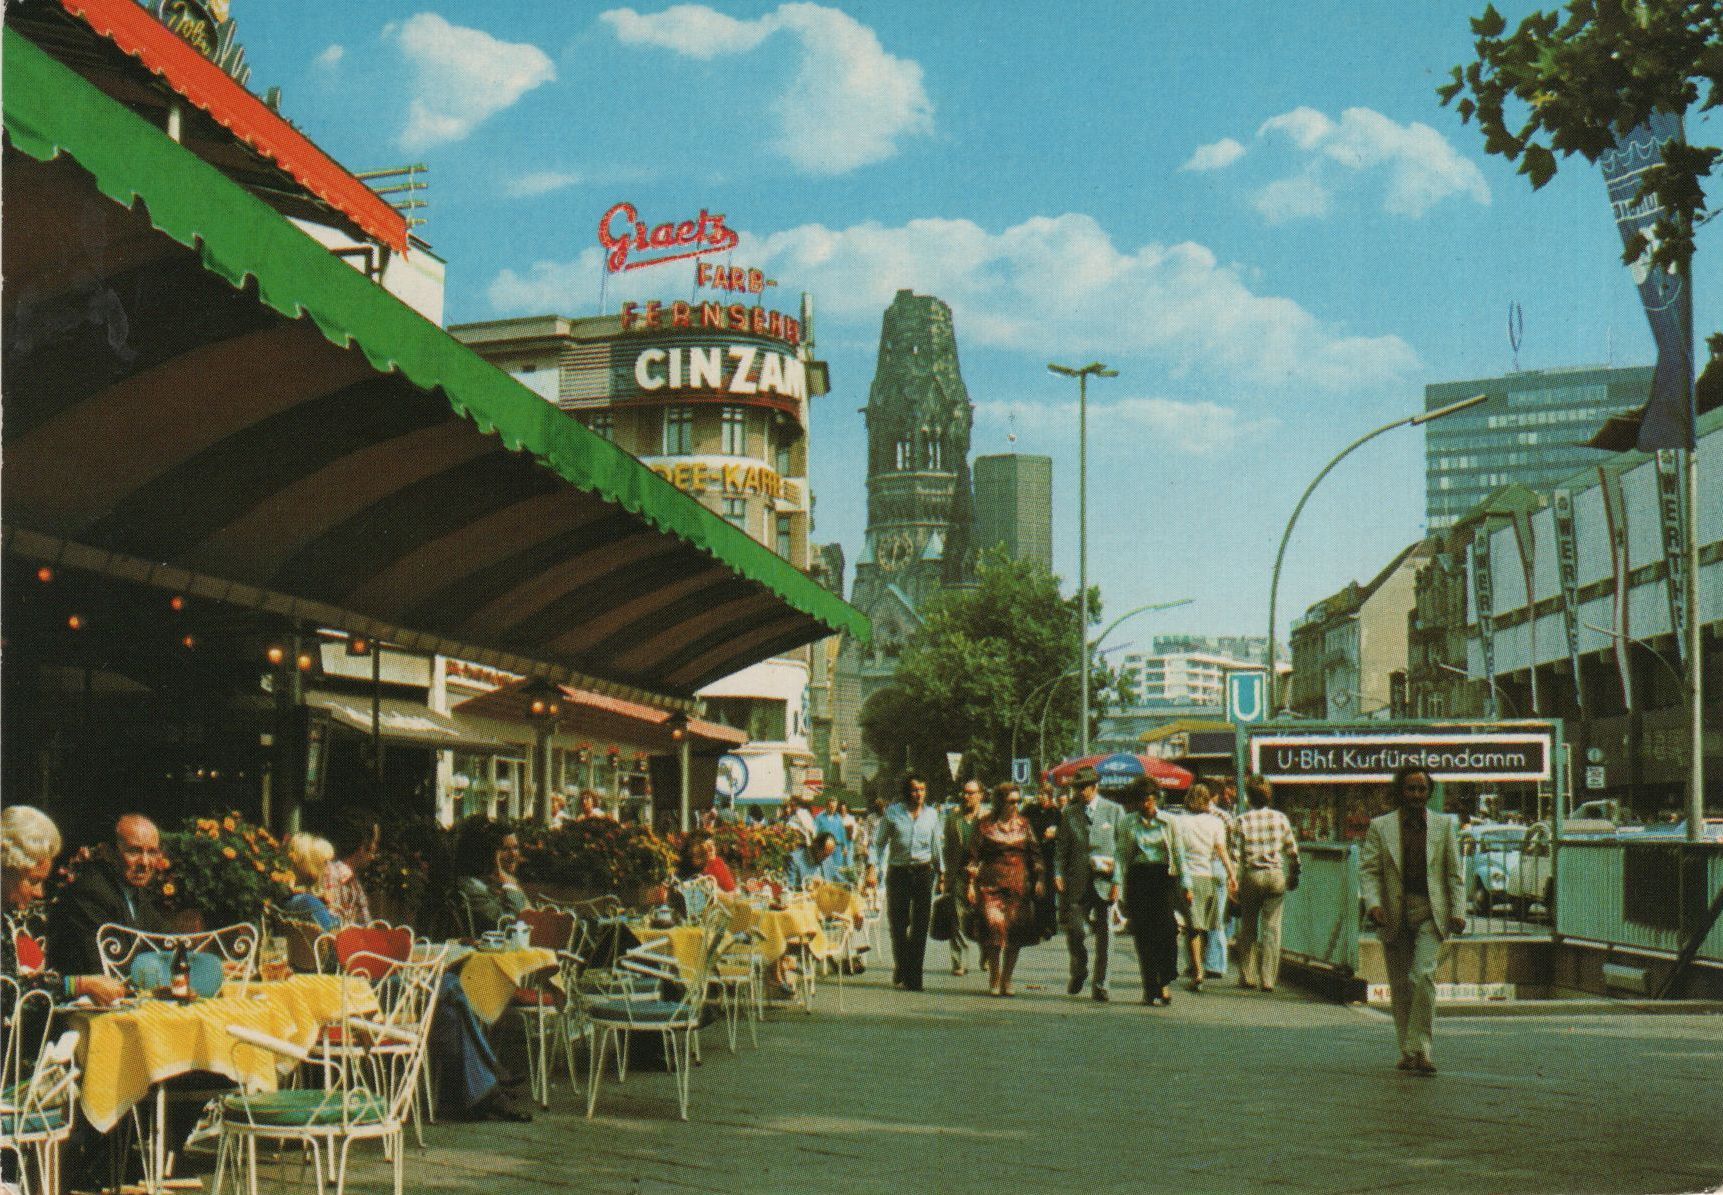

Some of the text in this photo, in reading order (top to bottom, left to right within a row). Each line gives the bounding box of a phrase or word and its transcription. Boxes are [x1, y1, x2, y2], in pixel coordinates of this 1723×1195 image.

[597, 201, 740, 273] Graetz
[697, 262, 778, 295] FARB-
[1232, 679, 1261, 721] U
[1014, 762, 1028, 783] U
[1342, 747, 1527, 770] Kurfürstendamm
